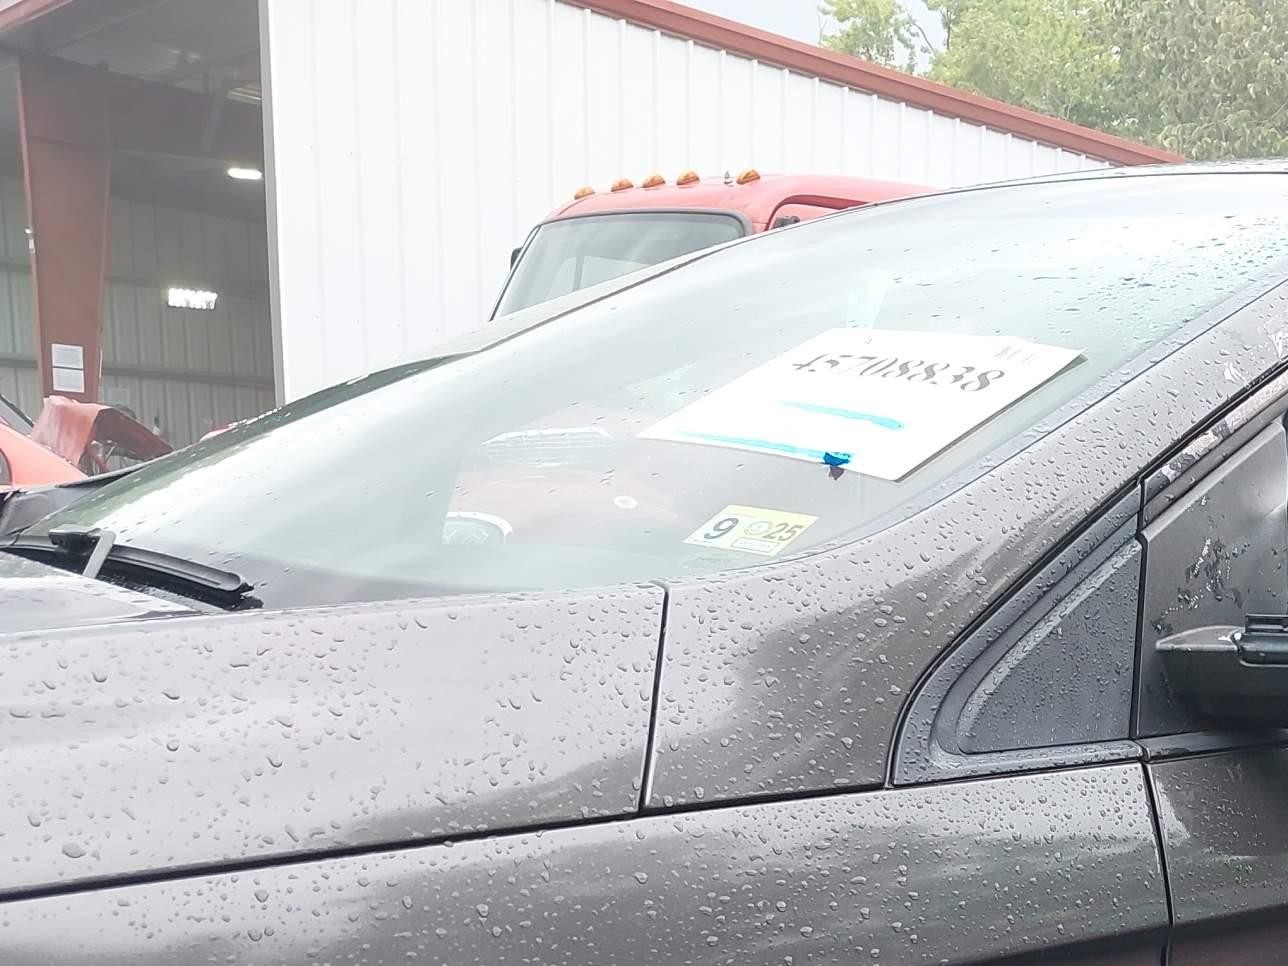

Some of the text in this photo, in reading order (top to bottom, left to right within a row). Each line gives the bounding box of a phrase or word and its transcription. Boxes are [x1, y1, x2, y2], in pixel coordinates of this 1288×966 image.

[792, 353, 1005, 392] 45708838
[703, 517, 804, 542] 9 25
